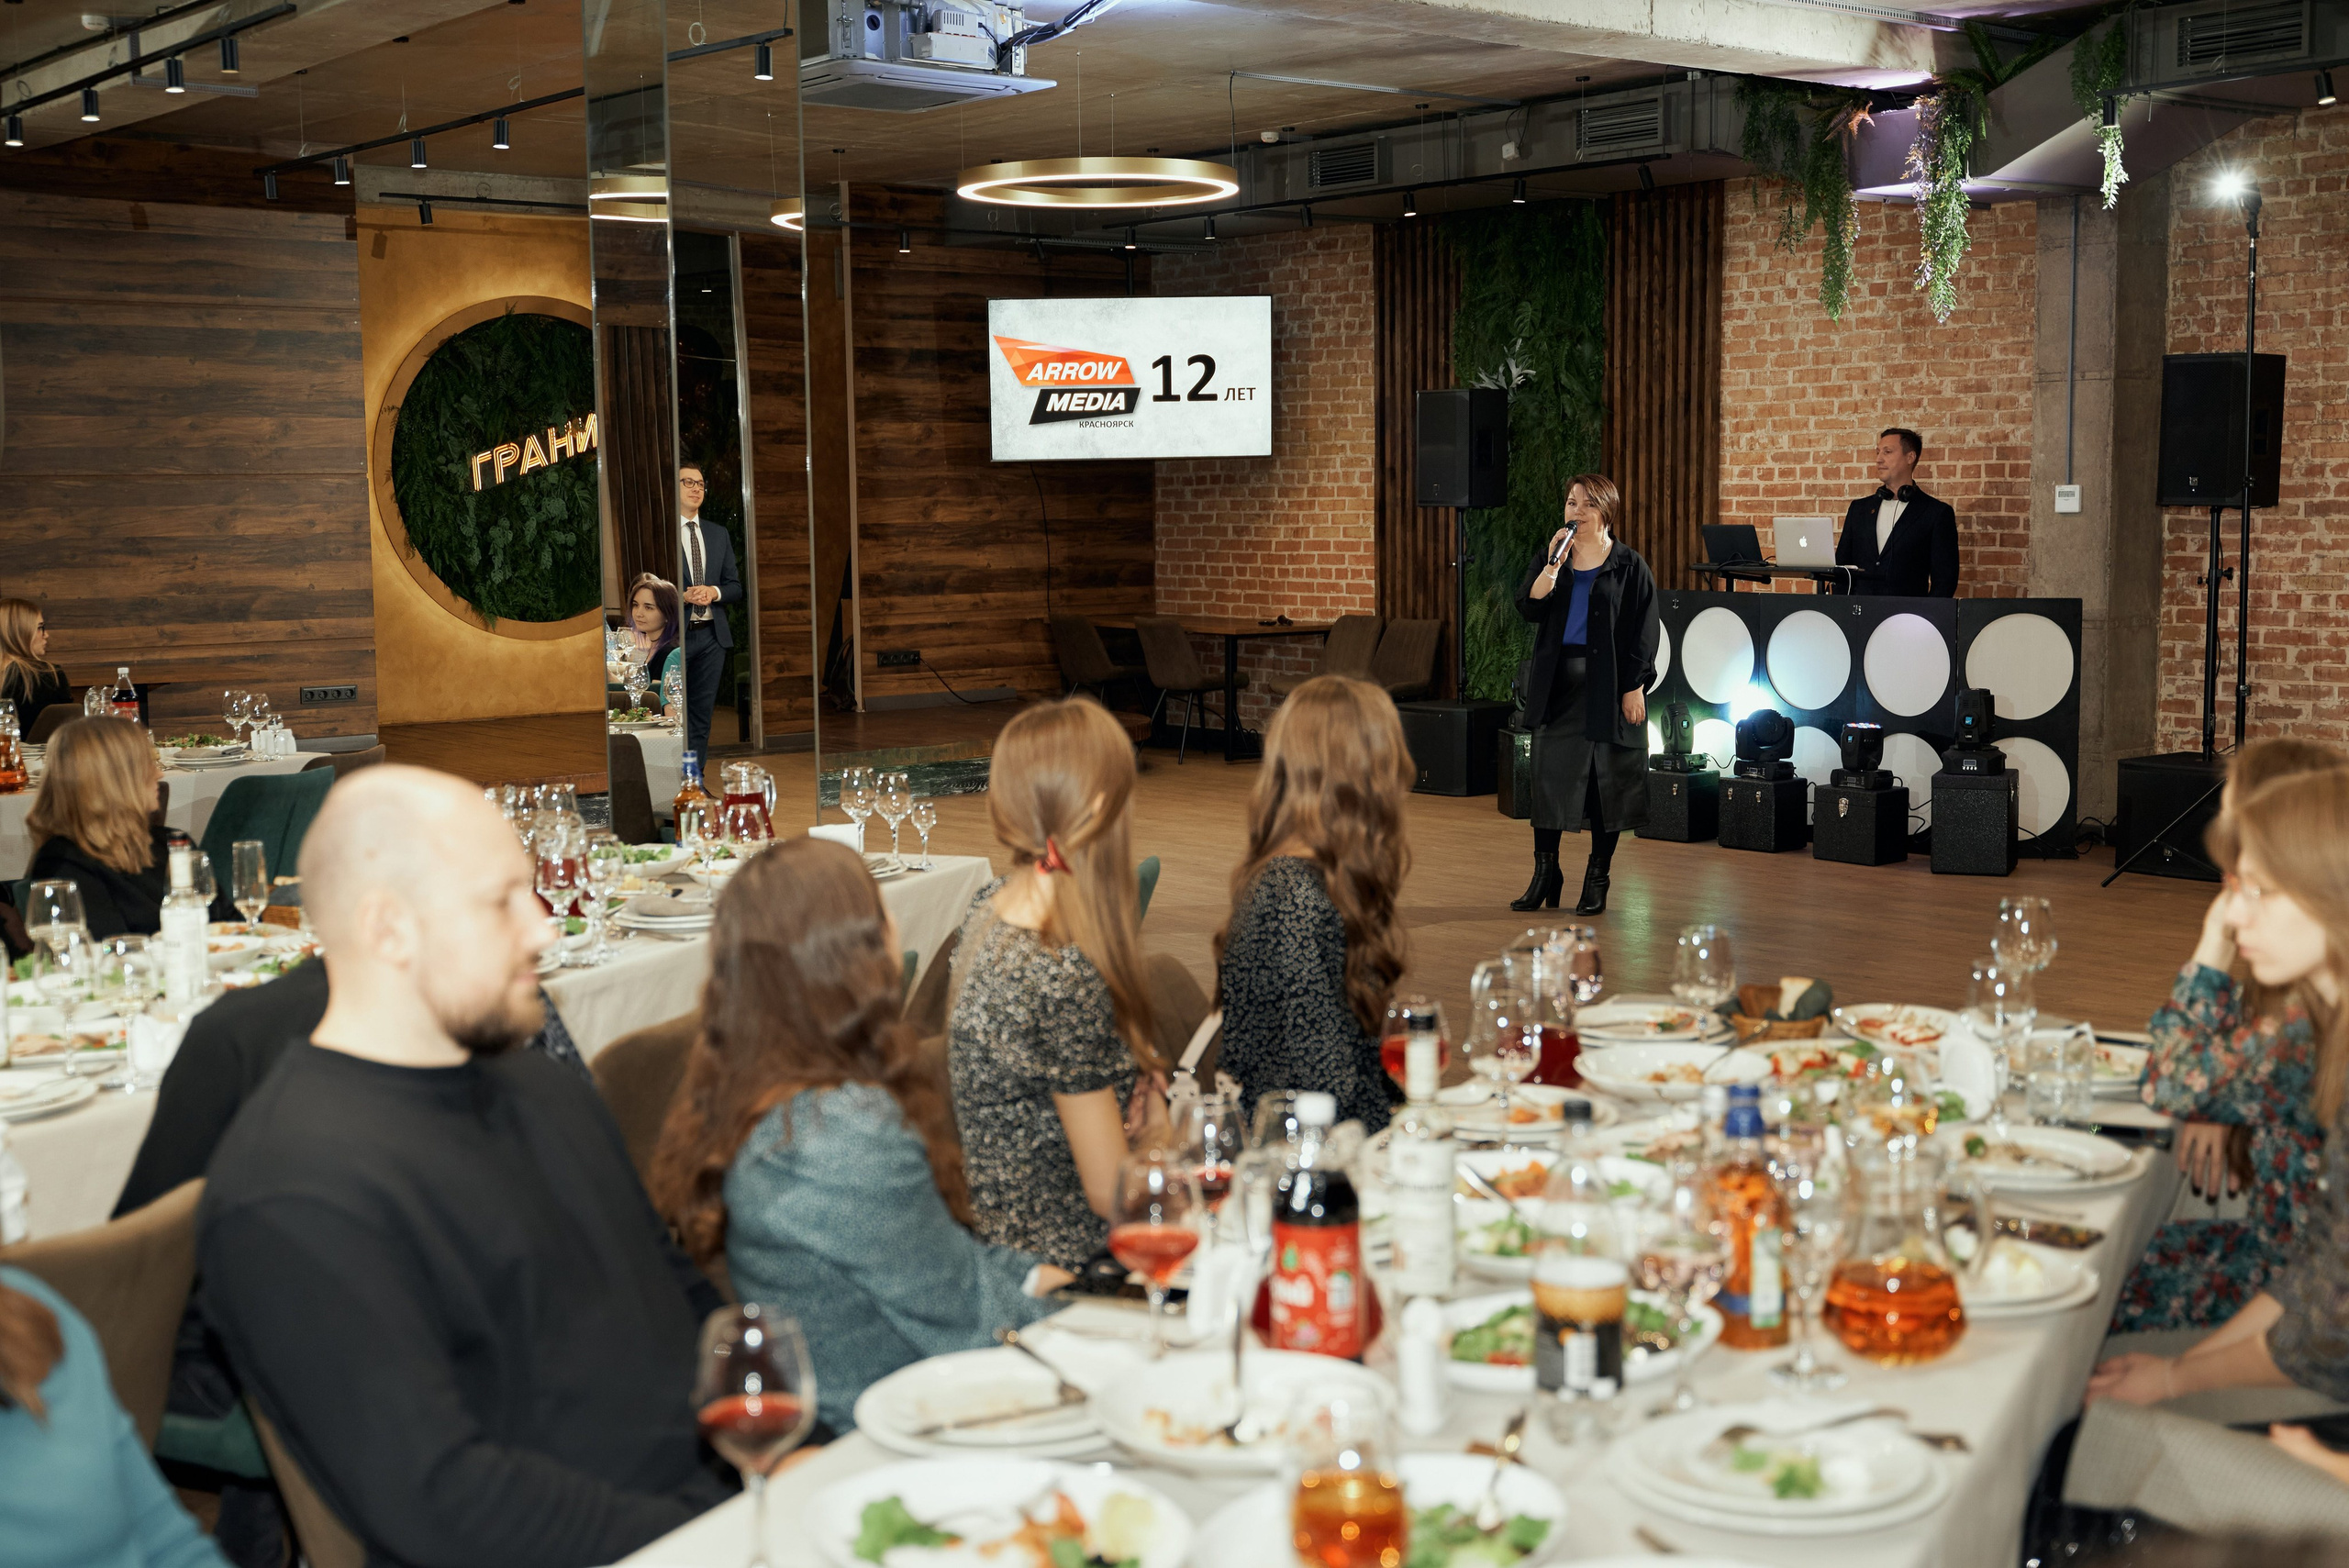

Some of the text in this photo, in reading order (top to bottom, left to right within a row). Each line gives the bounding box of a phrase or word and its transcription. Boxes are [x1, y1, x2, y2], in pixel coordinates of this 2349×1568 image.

[1026, 361, 1122, 381] ARROW
[1152, 353, 1257, 402] 12 ЛЕТ
[1045, 392, 1126, 411] MEDIA
[1078, 420, 1134, 428] КРАСНОЯРСК
[472, 412, 598, 492] ГРАНИ
